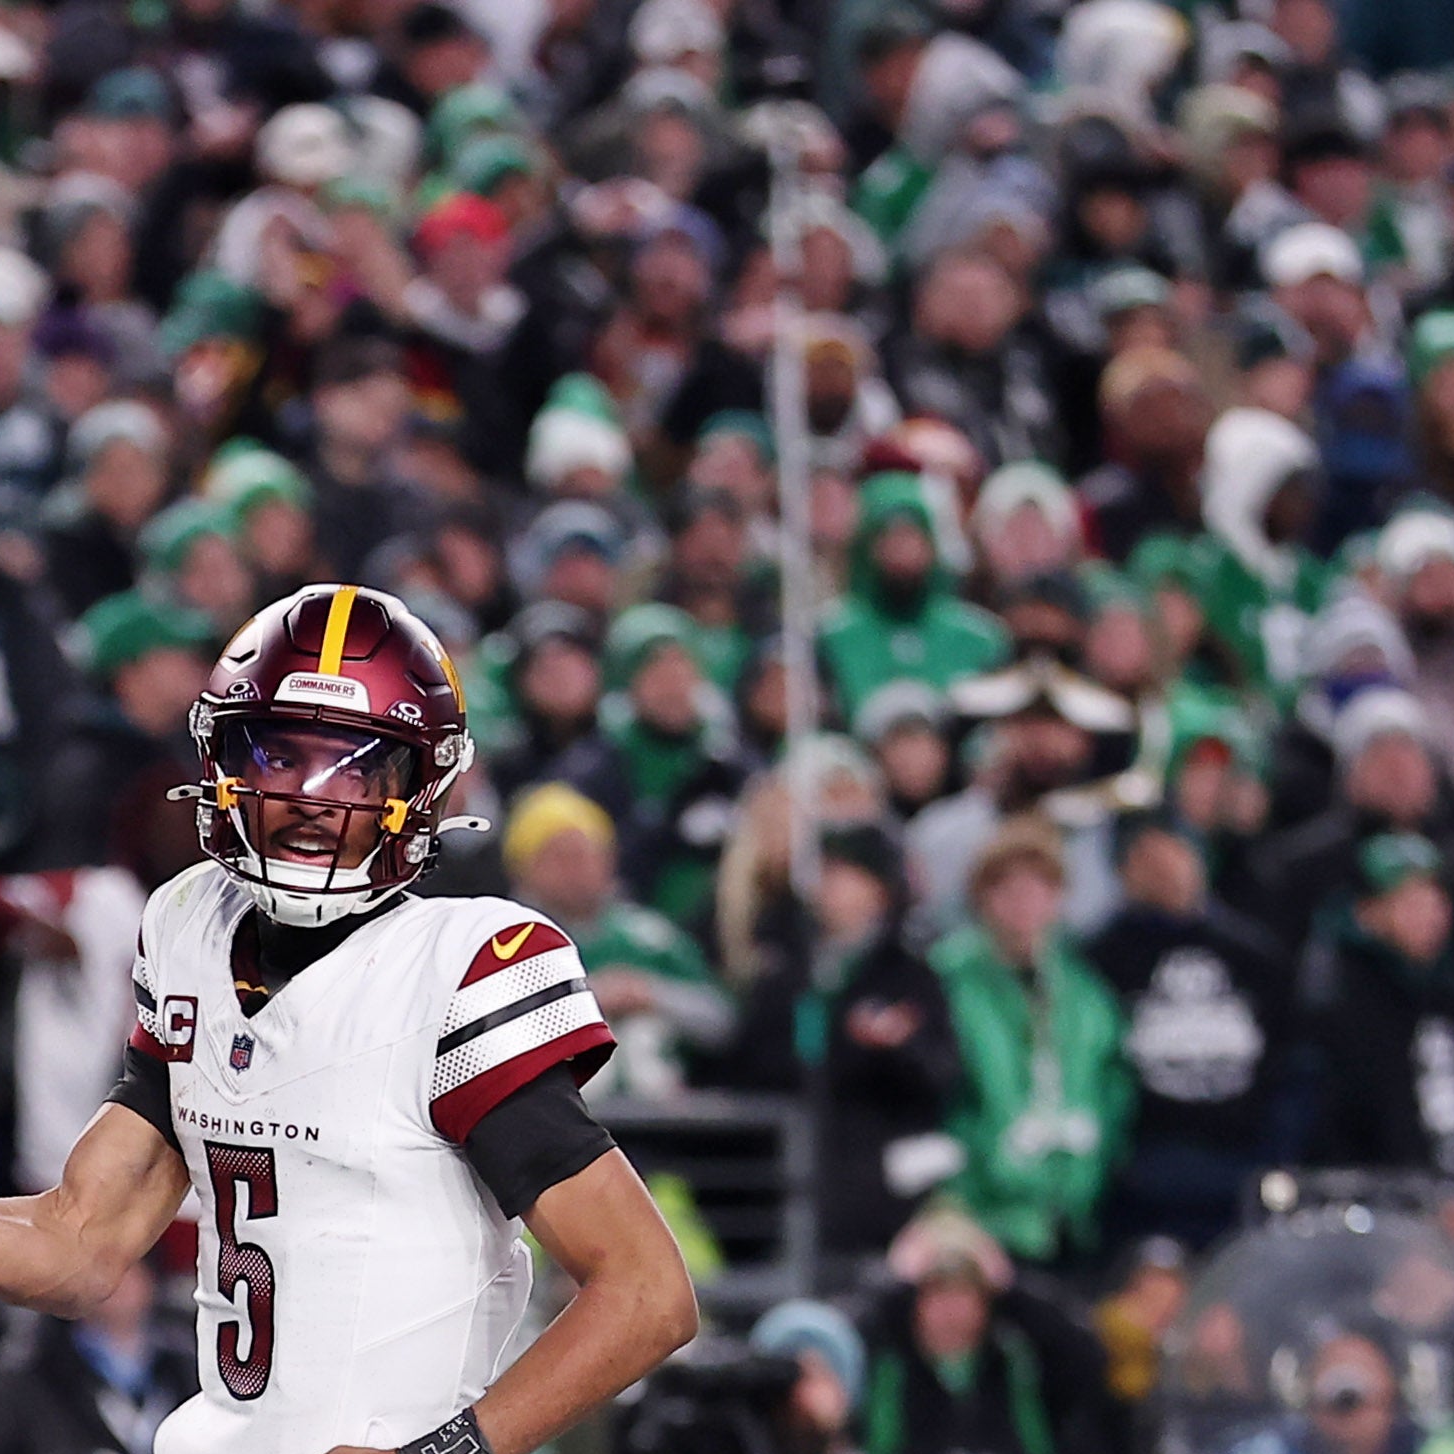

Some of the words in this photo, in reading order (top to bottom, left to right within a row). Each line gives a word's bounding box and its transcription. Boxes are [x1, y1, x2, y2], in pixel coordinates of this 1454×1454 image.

[289, 679, 356, 696] COMMANDERS
[164, 1000, 194, 1046] C
[178, 1106, 320, 1141] WASHINGTON
[203, 1139, 279, 1401] 5
